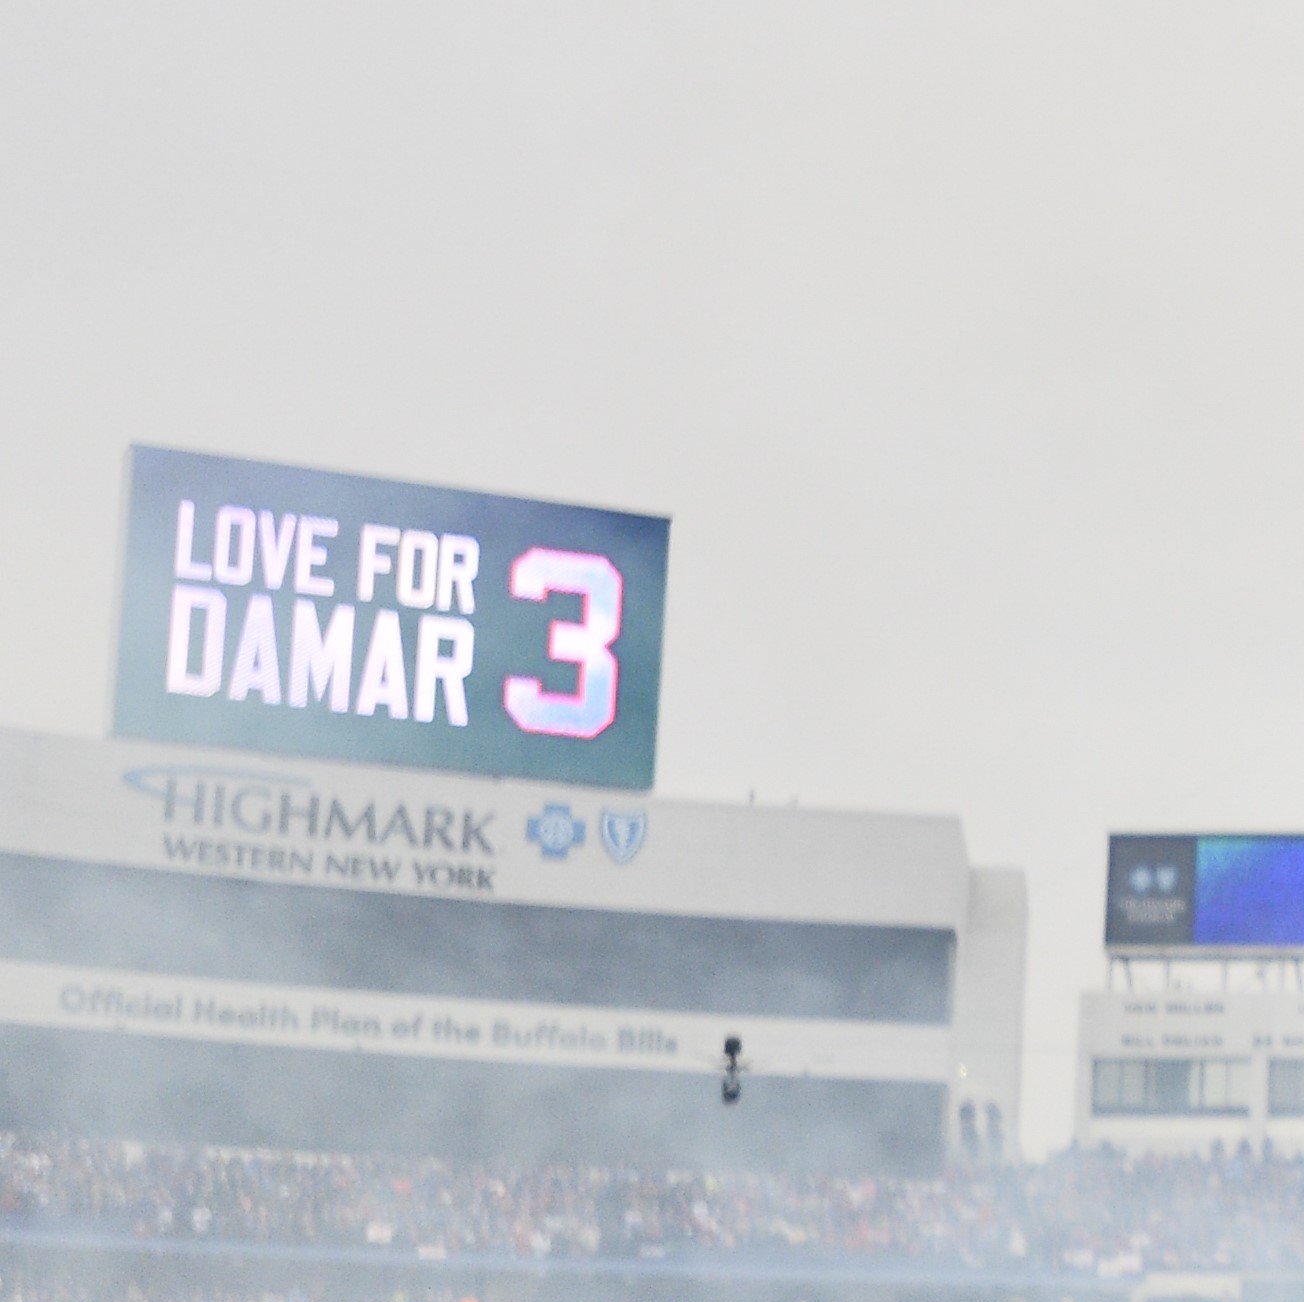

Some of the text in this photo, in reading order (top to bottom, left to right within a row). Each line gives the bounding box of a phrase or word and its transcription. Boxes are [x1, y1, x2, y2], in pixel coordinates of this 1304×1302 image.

[174, 500, 480, 614] LOVE FOR
[165, 583, 476, 727] DAMAR
[504, 546, 623, 739] 3
[162, 830, 497, 891] WESTERN NEW YORK
[163, 776, 497, 857] HIGHMARK
